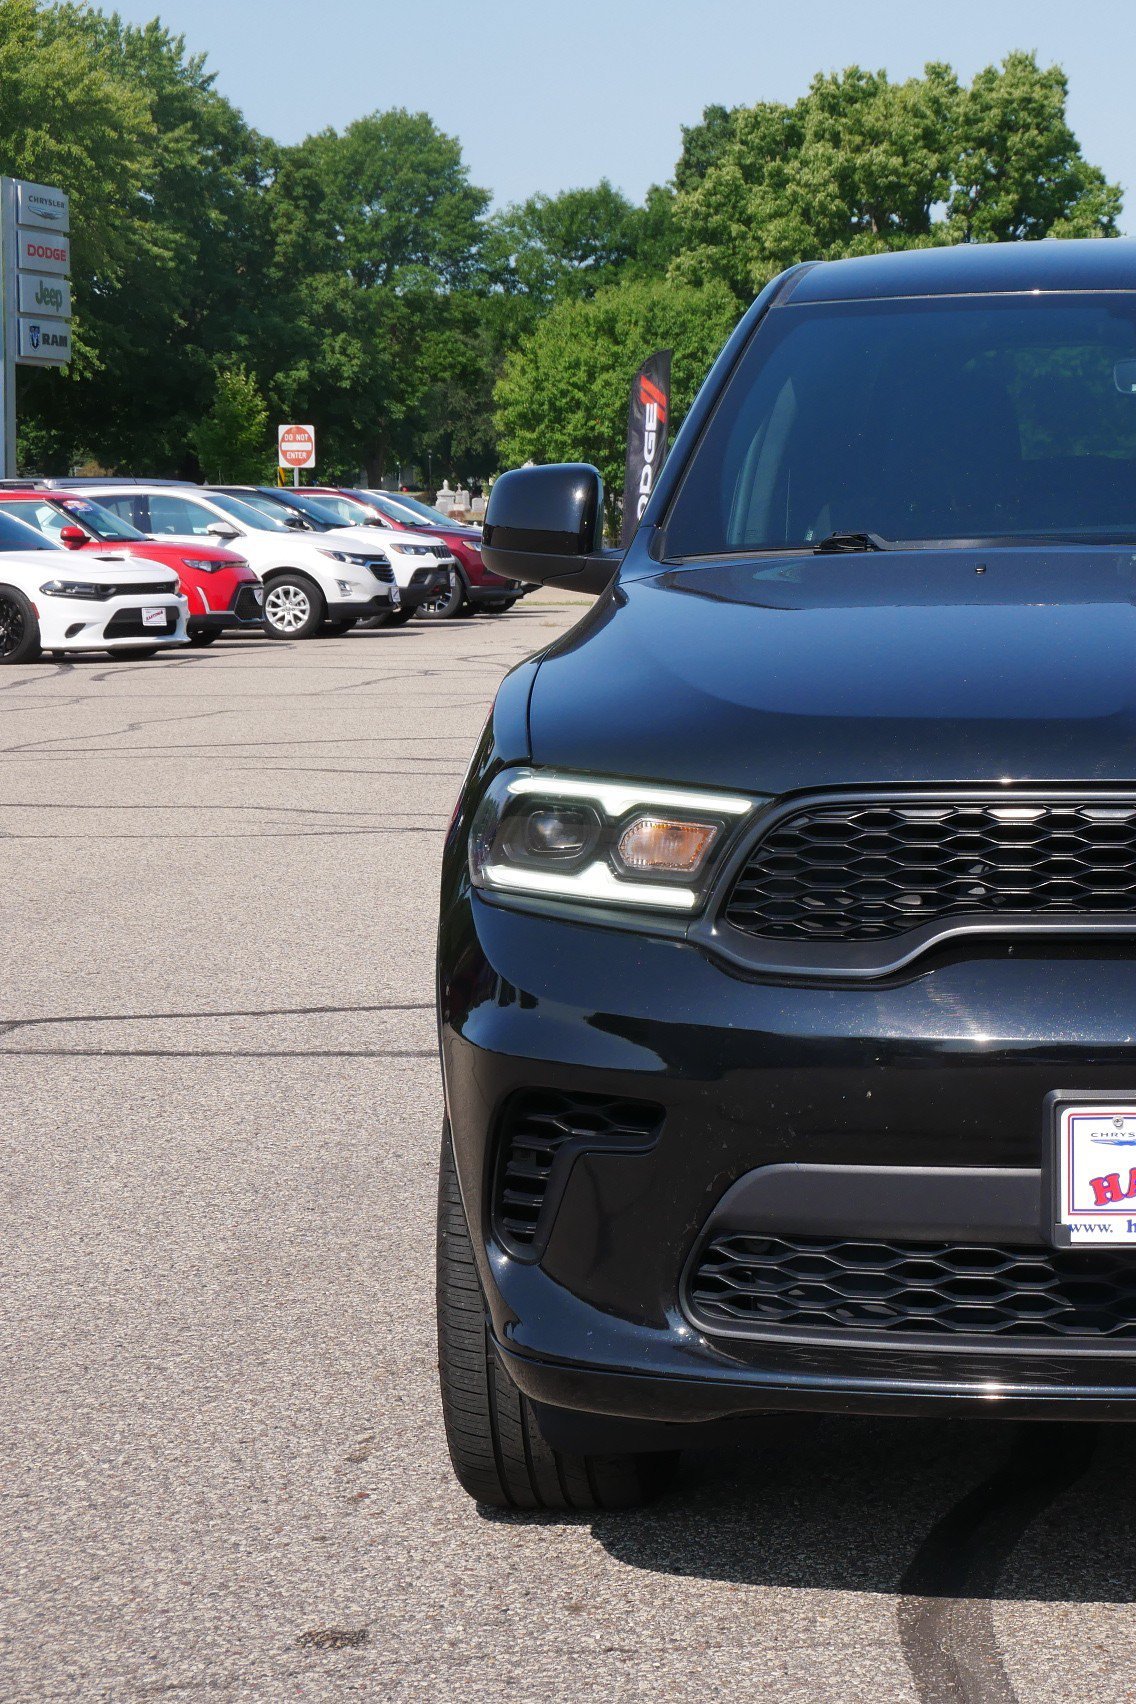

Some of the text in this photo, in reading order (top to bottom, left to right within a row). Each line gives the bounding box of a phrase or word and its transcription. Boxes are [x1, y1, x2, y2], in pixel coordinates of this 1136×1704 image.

[28, 195, 65, 208] CHRYSLER
[27, 243, 67, 262] DODGE
[35, 280, 63, 312] Jeep
[41, 332, 68, 348] RAM
